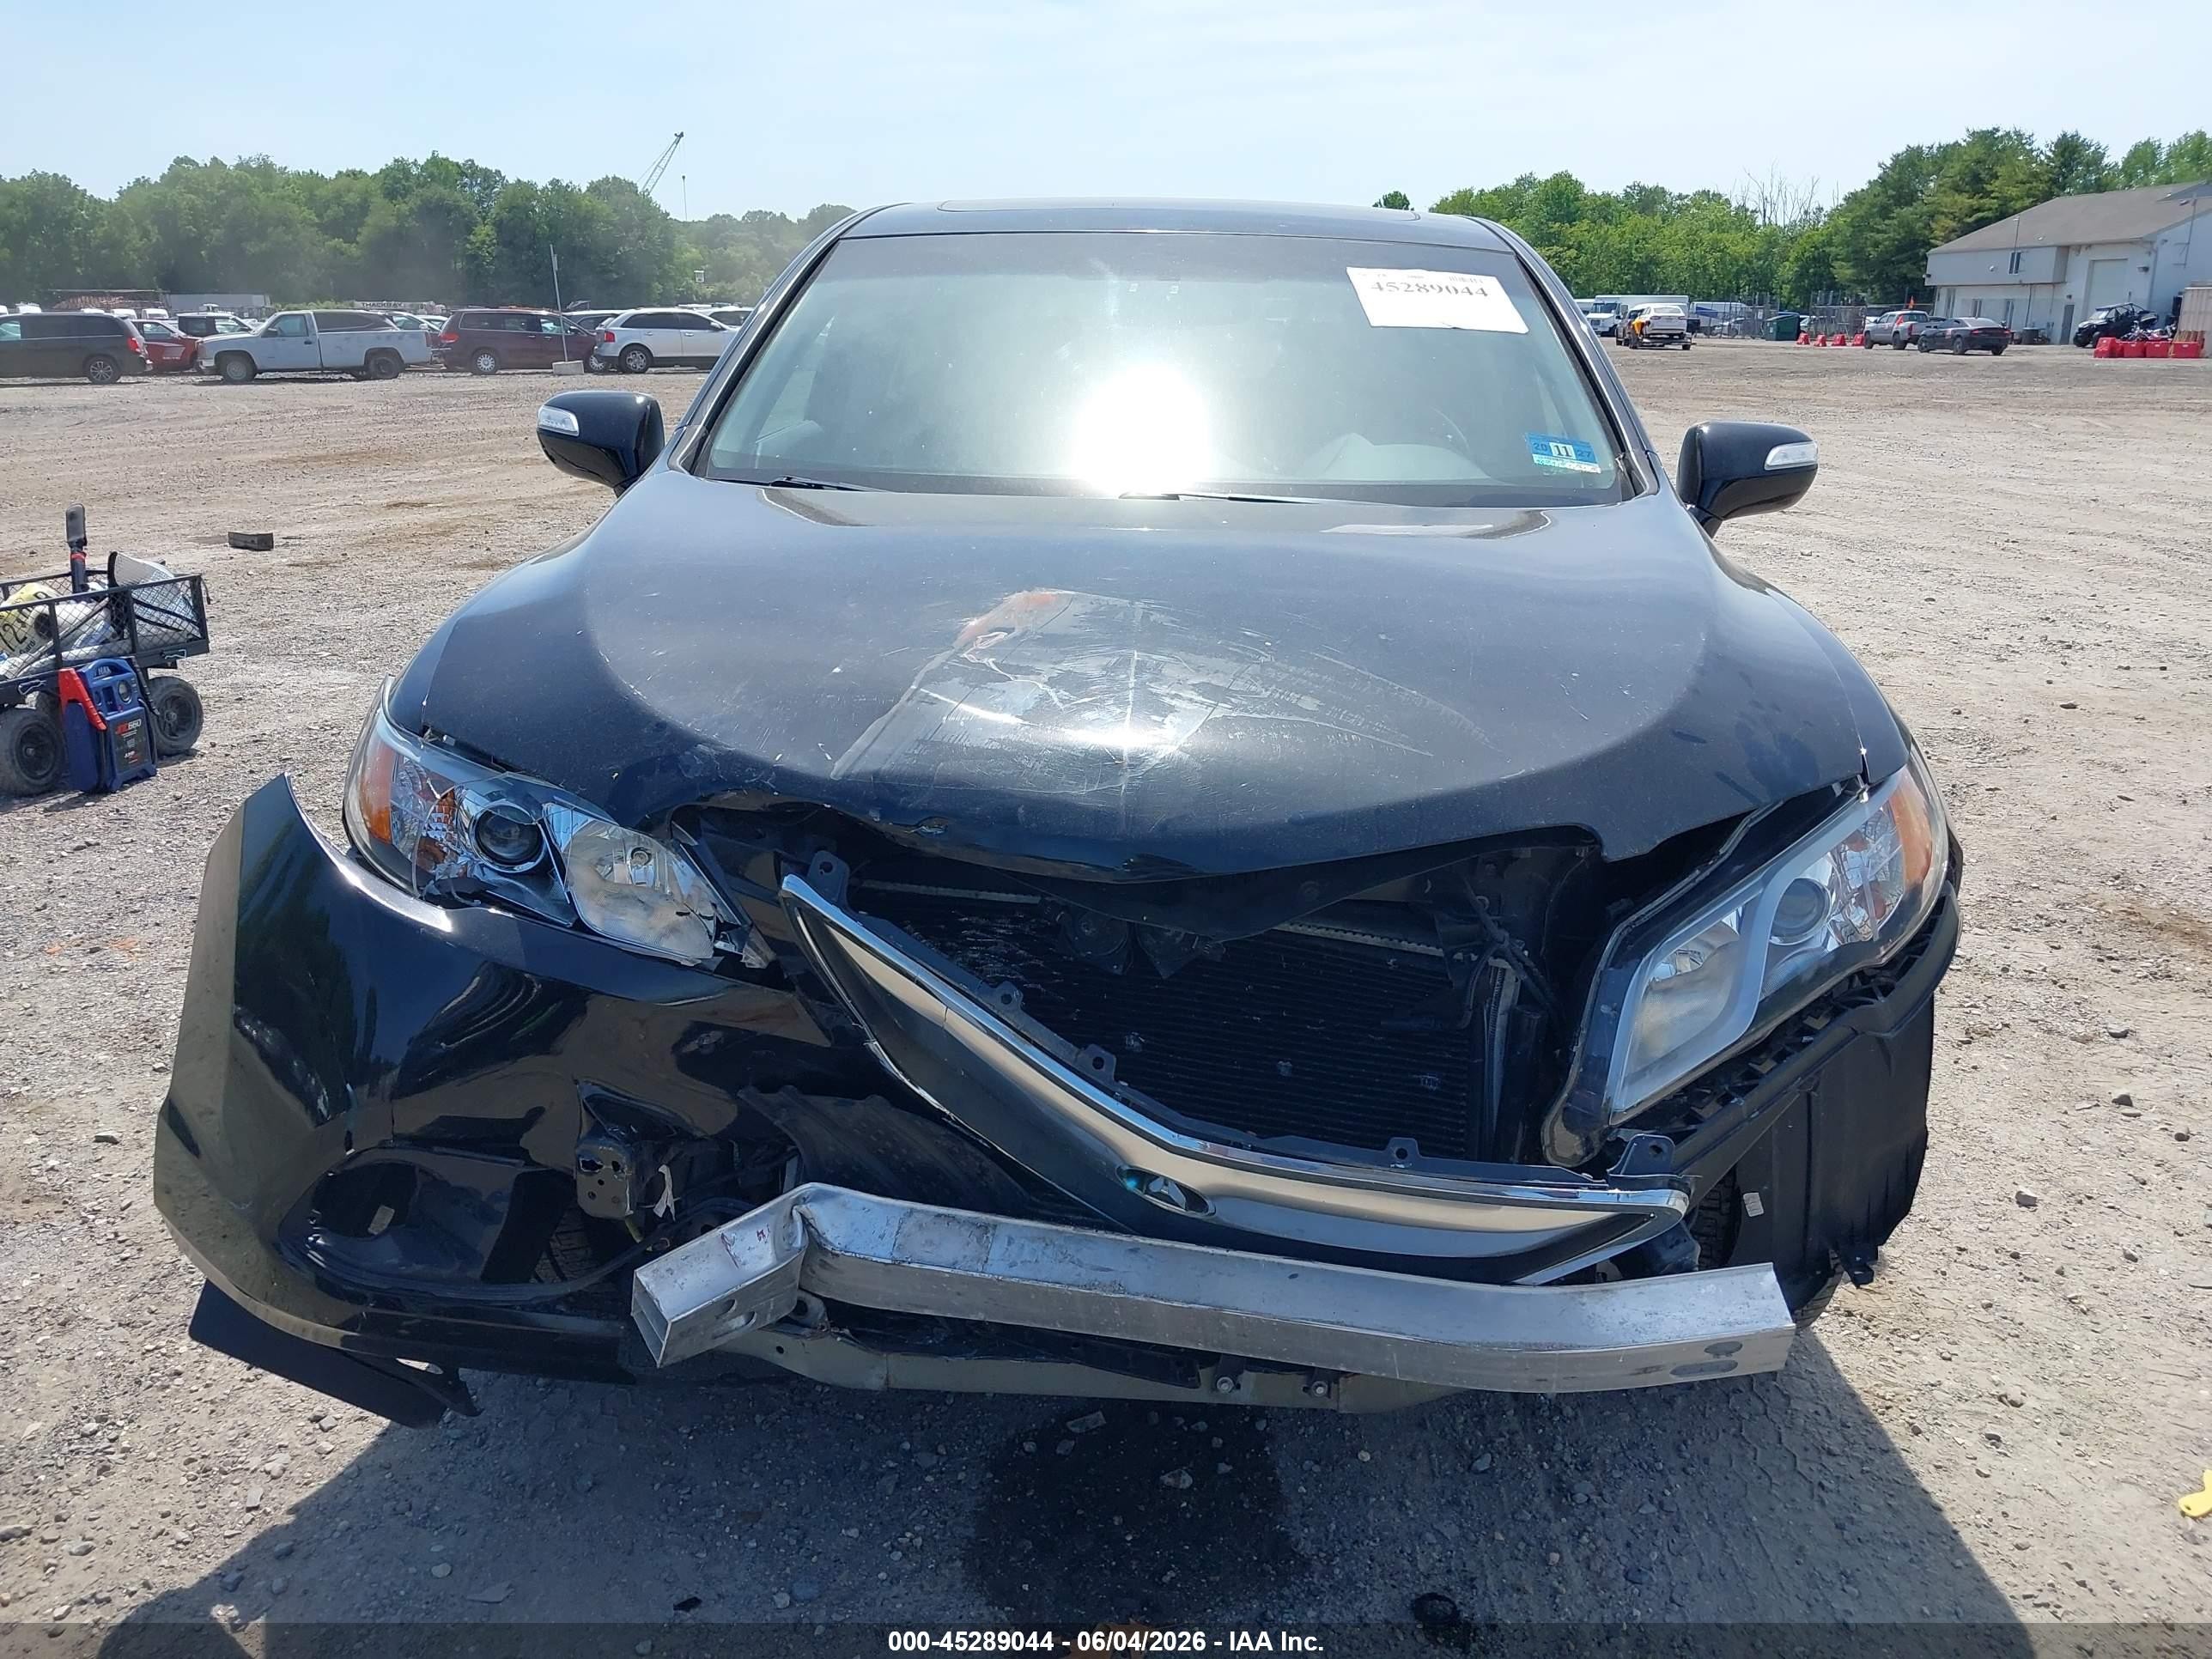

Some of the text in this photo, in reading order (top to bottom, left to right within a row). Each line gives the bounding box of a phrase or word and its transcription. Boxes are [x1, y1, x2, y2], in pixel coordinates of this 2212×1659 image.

[1371, 282, 1489, 297] 45289044
[1533, 442, 1591, 458] 20 11 27
